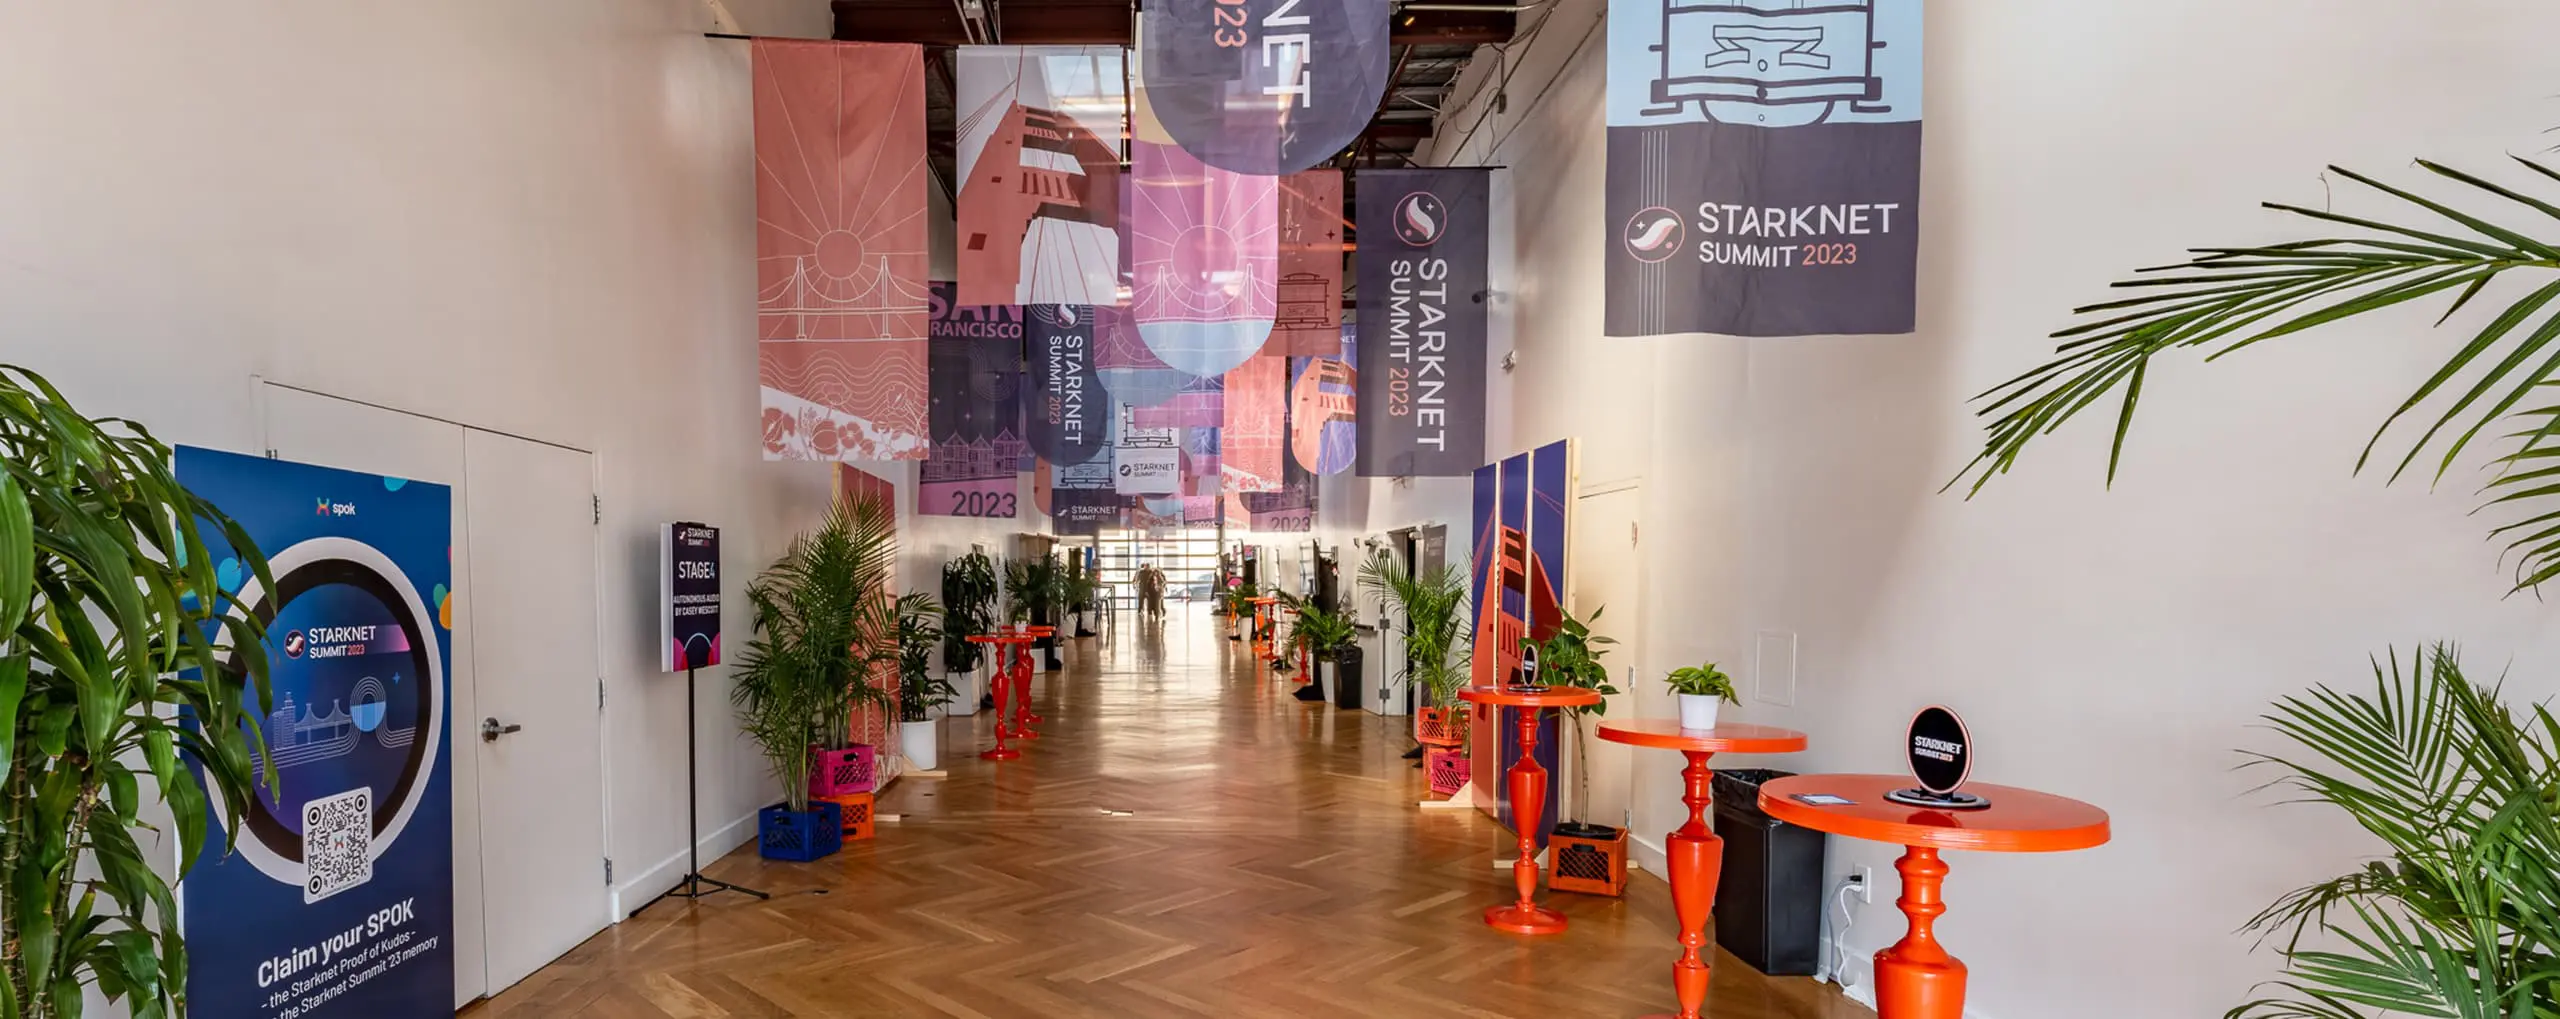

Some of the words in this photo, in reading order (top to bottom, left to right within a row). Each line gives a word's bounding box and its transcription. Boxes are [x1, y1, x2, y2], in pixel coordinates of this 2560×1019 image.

[1214, 0, 1247, 48] 23
[1698, 201, 1899, 238] STARKNET
[1699, 240, 1798, 268] SUMMIT
[1801, 243, 1857, 266] 2023
[1390, 259, 1411, 363] SUMMIT
[930, 321, 1023, 339] RANCISCO
[1049, 335, 1062, 395] SUMMIT
[1417, 257, 1448, 452] STARKNET
[1064, 335, 1083, 446] STARKNET
[1388, 367, 1410, 417] 2023
[1048, 396, 1062, 425] 2023
[1133, 463, 1176, 471] STARKNET
[332, 501, 356, 517] spok
[951, 490, 1017, 519] 2023
[1071, 505, 1117, 515] STARKNET
[687, 527, 715, 540] STARKNET
[1271, 516, 1311, 533] 2023
[675, 607, 682, 617] BY
[682, 606, 698, 616] CASEY
[309, 625, 377, 645] STARKNET
[309, 645, 348, 659] SUMMIT
[347, 643, 365, 656] 2023
[1914, 735, 1963, 755] STARKNET
[258, 945, 318, 989] Claim
[321, 924, 364, 966] your
[367, 897, 415, 938] SPOK
[270, 989, 290, 1009] the
[291, 964, 338, 998] Starknet
[340, 947, 368, 974] Proof
[369, 942, 380, 959] of
[381, 930, 411, 953] Kudos
[280, 1006, 300, 1019] the
[301, 979, 347, 1014] Starknet
[348, 959, 388, 989] Summit
[402, 935, 439, 961] memory
